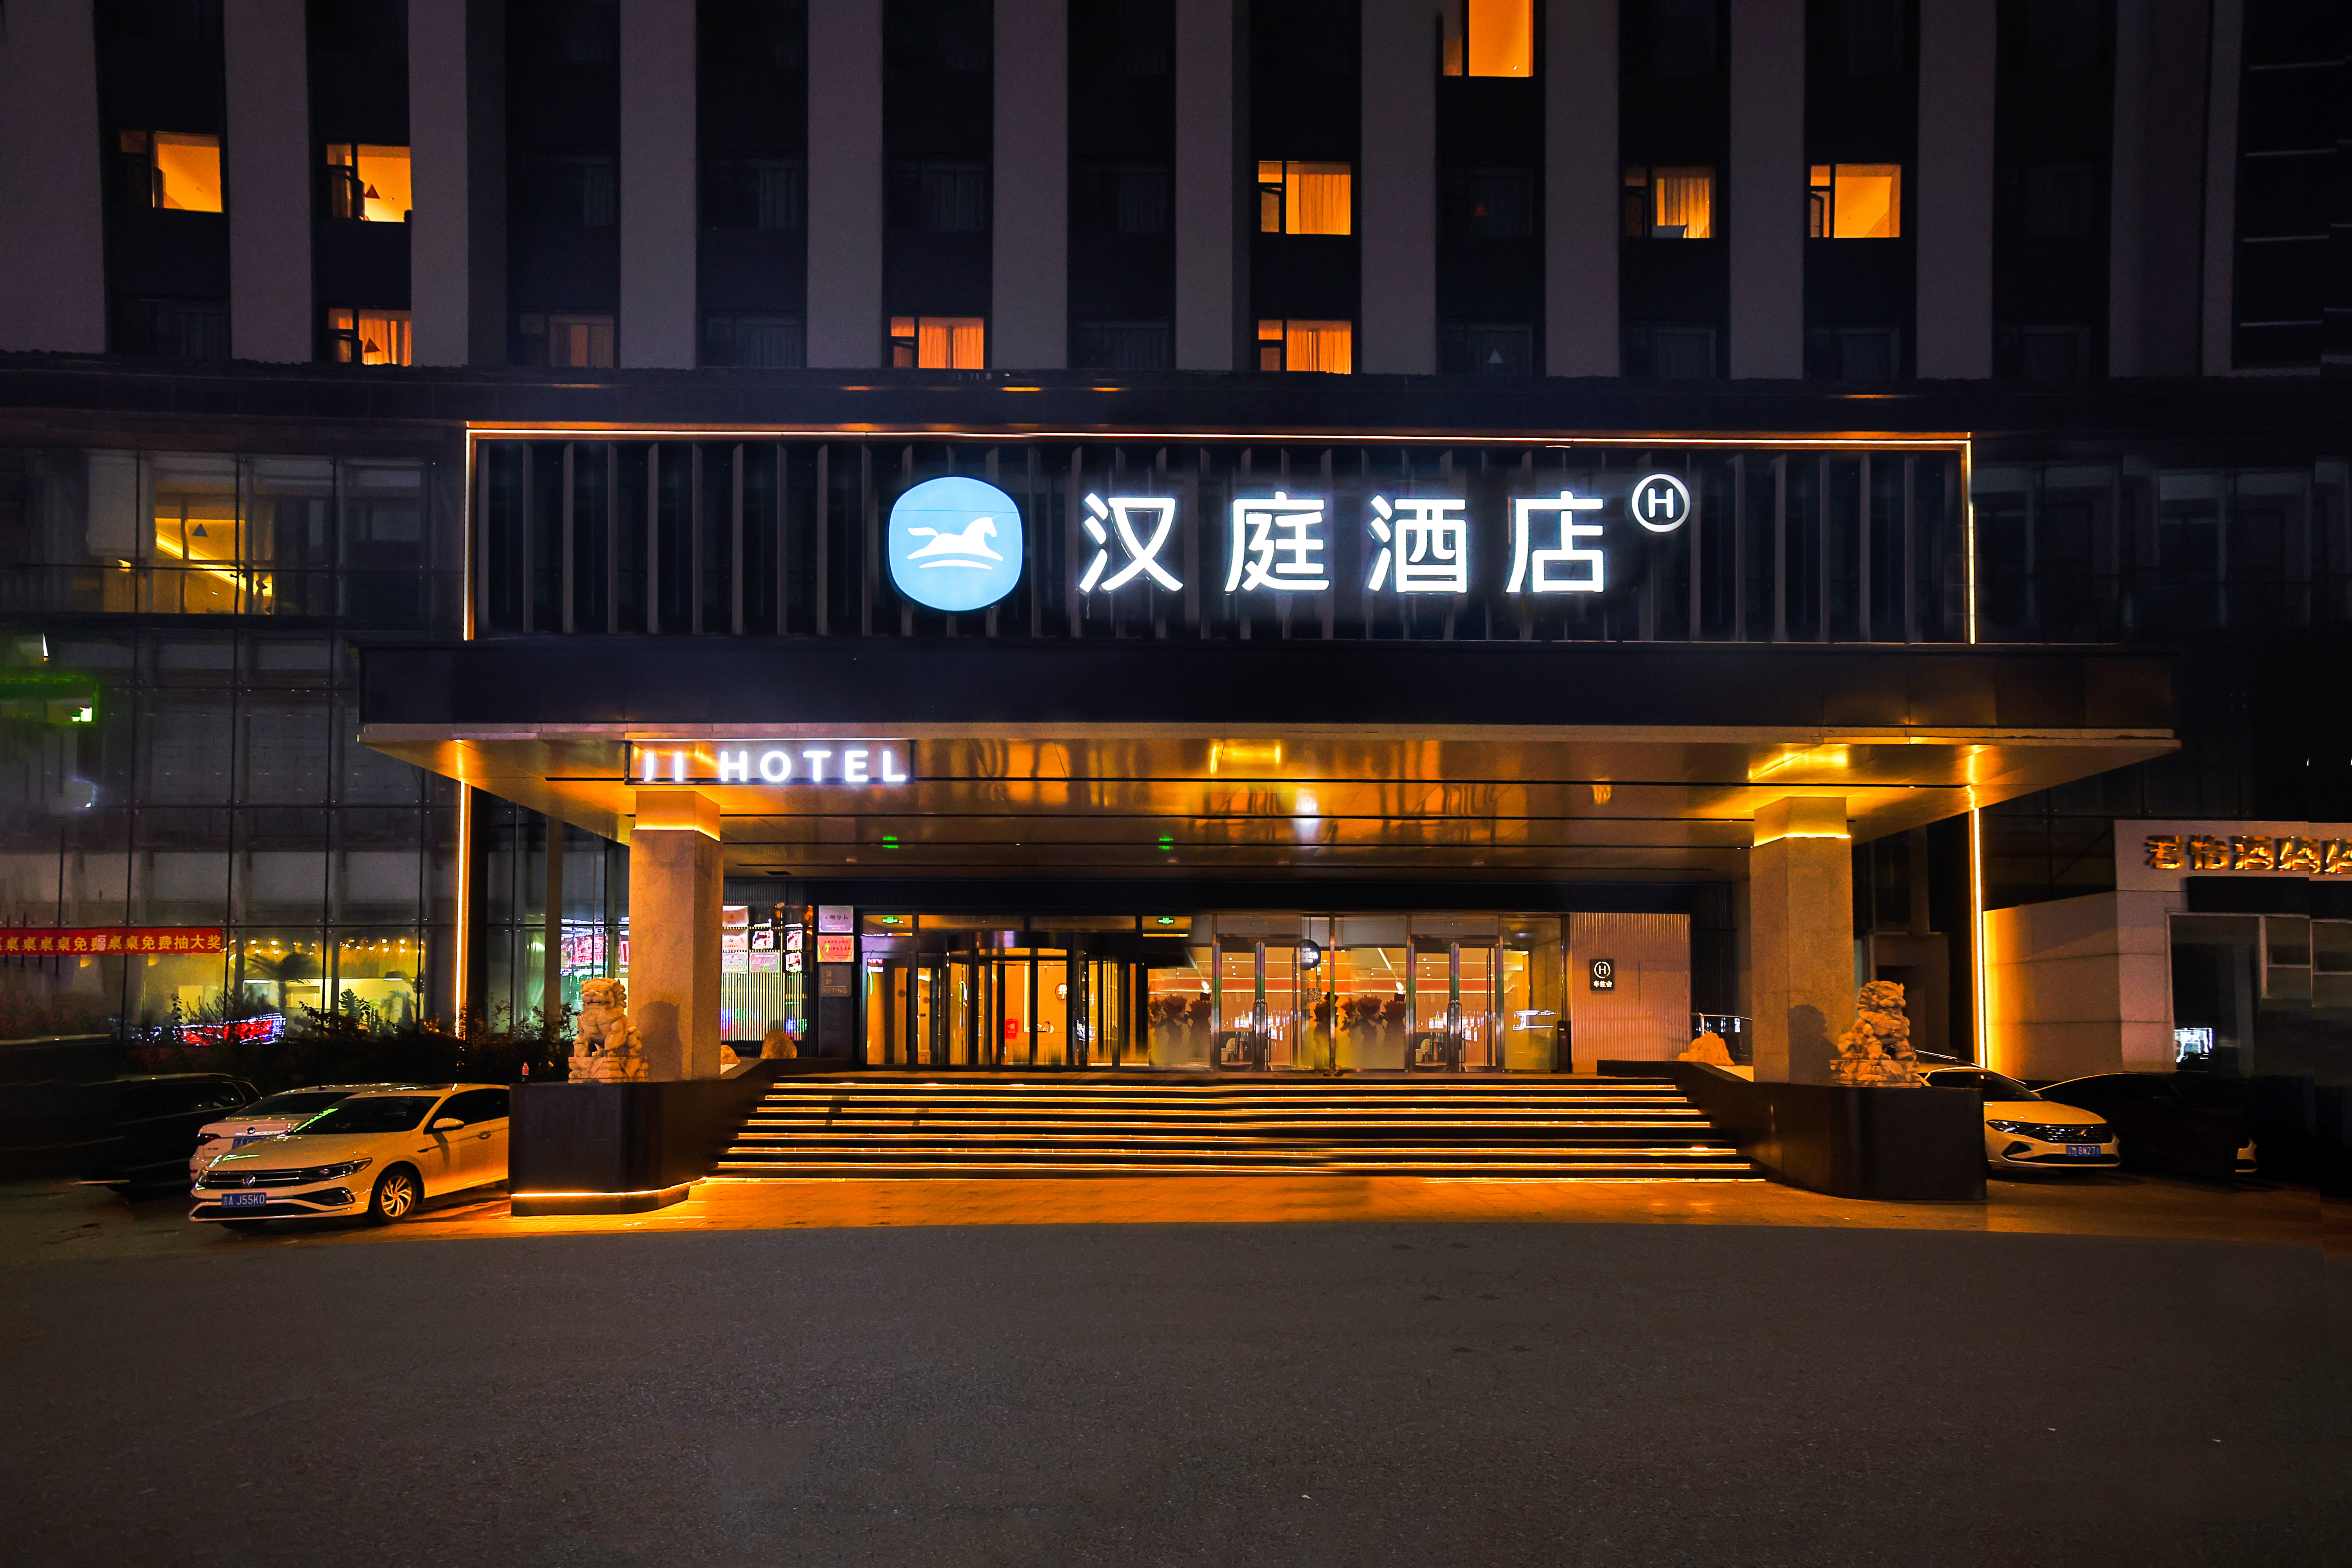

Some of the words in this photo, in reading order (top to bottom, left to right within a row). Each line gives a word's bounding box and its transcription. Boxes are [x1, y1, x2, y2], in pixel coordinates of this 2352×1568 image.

[1079, 491, 1604, 595] 汉庭酒店
[643, 752, 683, 782] JI
[719, 750, 906, 782] HOTEL
